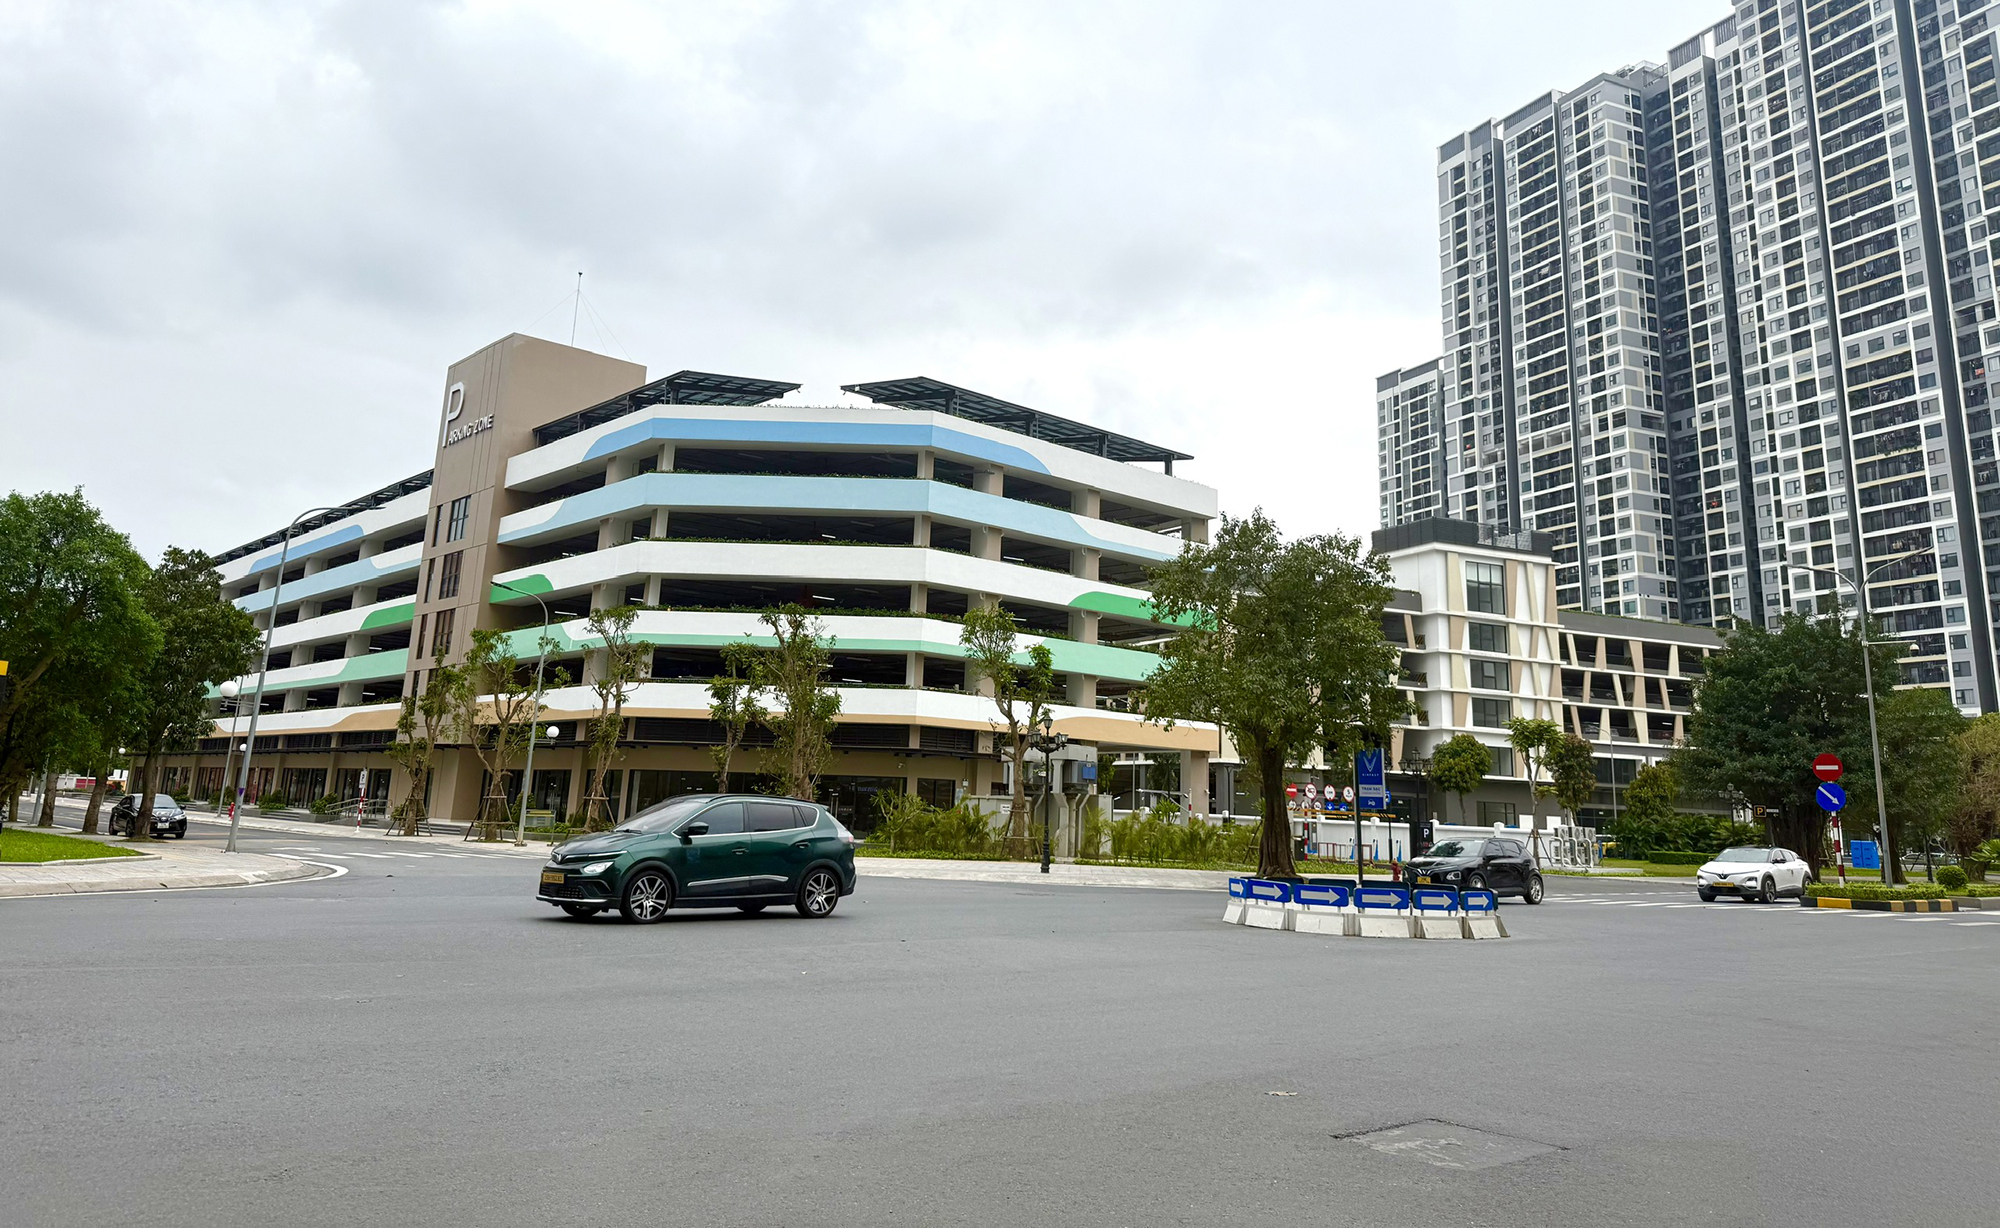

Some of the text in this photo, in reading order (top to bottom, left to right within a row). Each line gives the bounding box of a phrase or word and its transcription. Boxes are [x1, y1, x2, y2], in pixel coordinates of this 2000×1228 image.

[442, 381, 494, 448] PARKING ZONE
[1423, 828, 1429, 838] P
